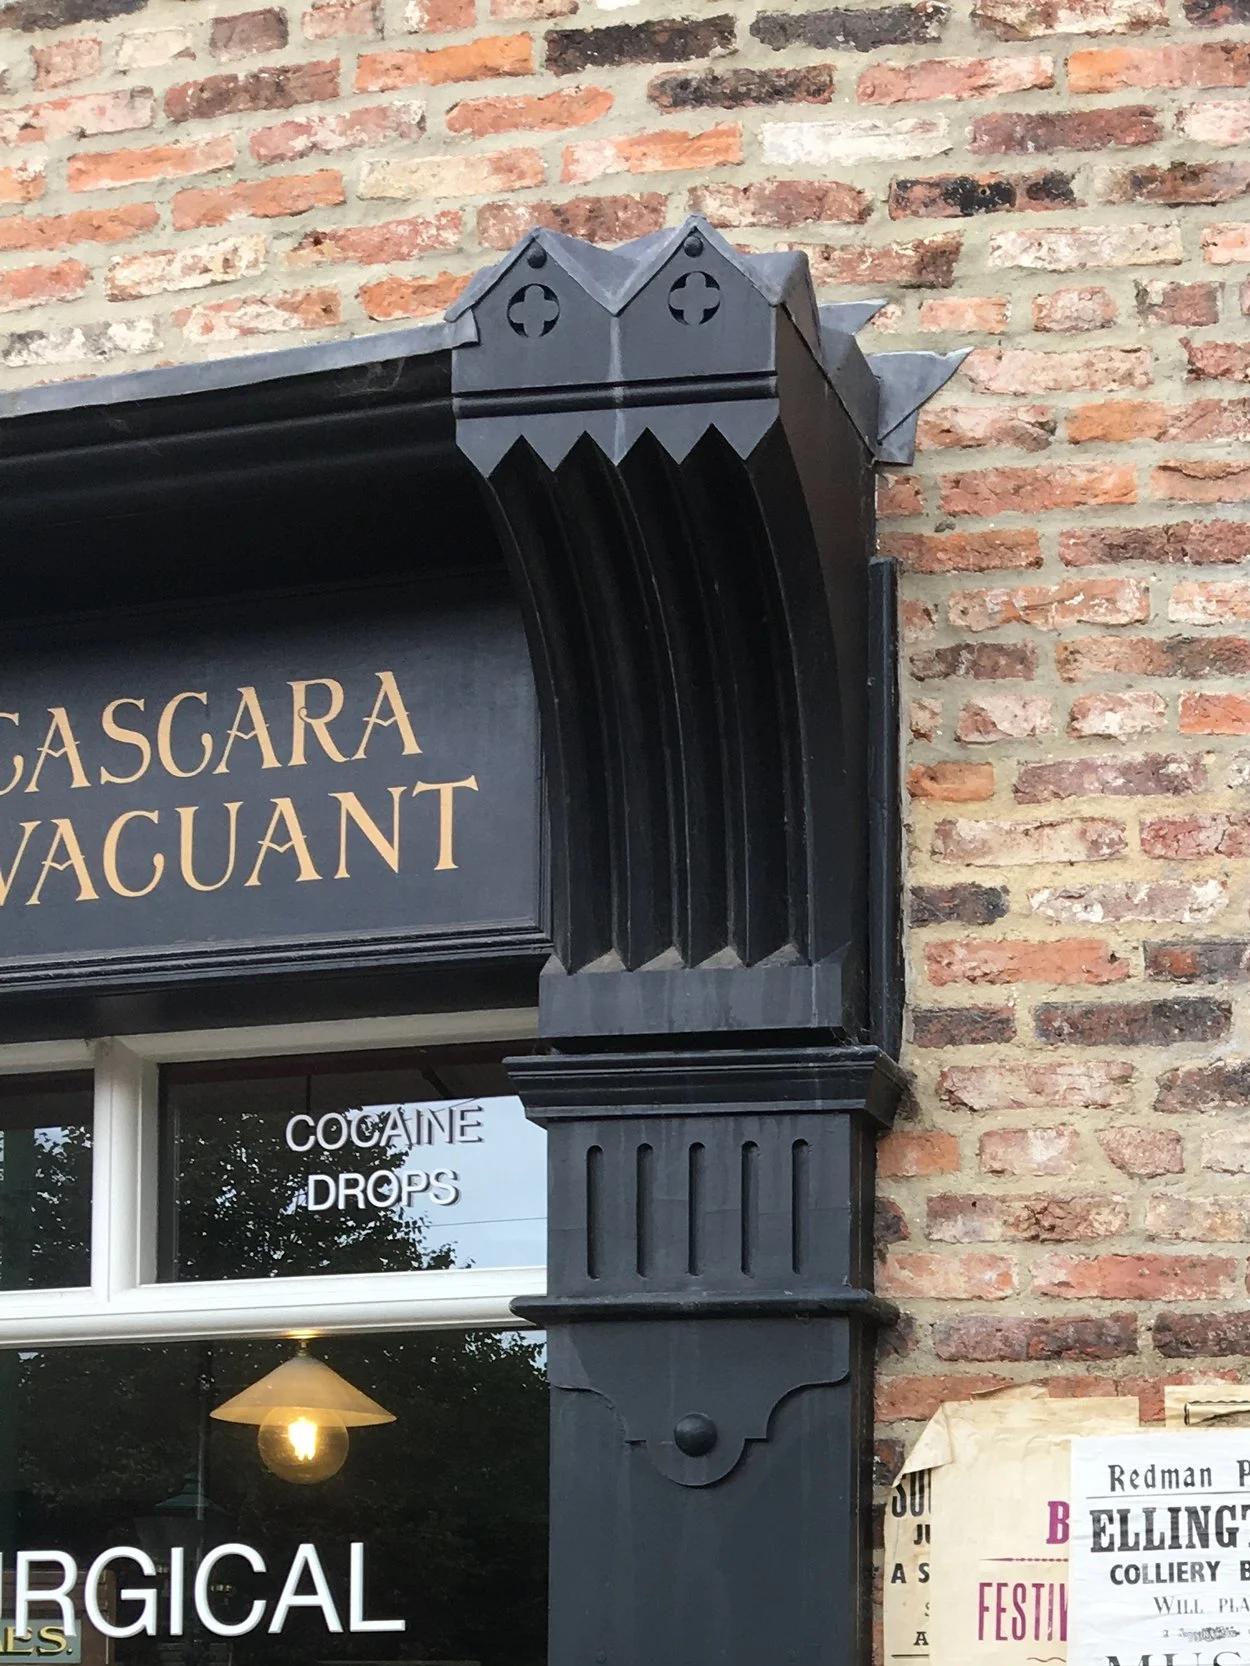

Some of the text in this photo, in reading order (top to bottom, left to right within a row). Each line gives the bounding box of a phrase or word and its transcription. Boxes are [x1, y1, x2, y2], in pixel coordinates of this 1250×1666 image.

[285, 1105, 484, 1153] COCAINE
[307, 1168, 461, 1212] DROPS
[1108, 1464, 1212, 1492] Redman
[891, 1563, 906, 1583] A
[1110, 1561, 1221, 1586] COLLIERY
[0, 1542, 406, 1638] RGICAL
[1153, 1595, 1204, 1614] WILL
